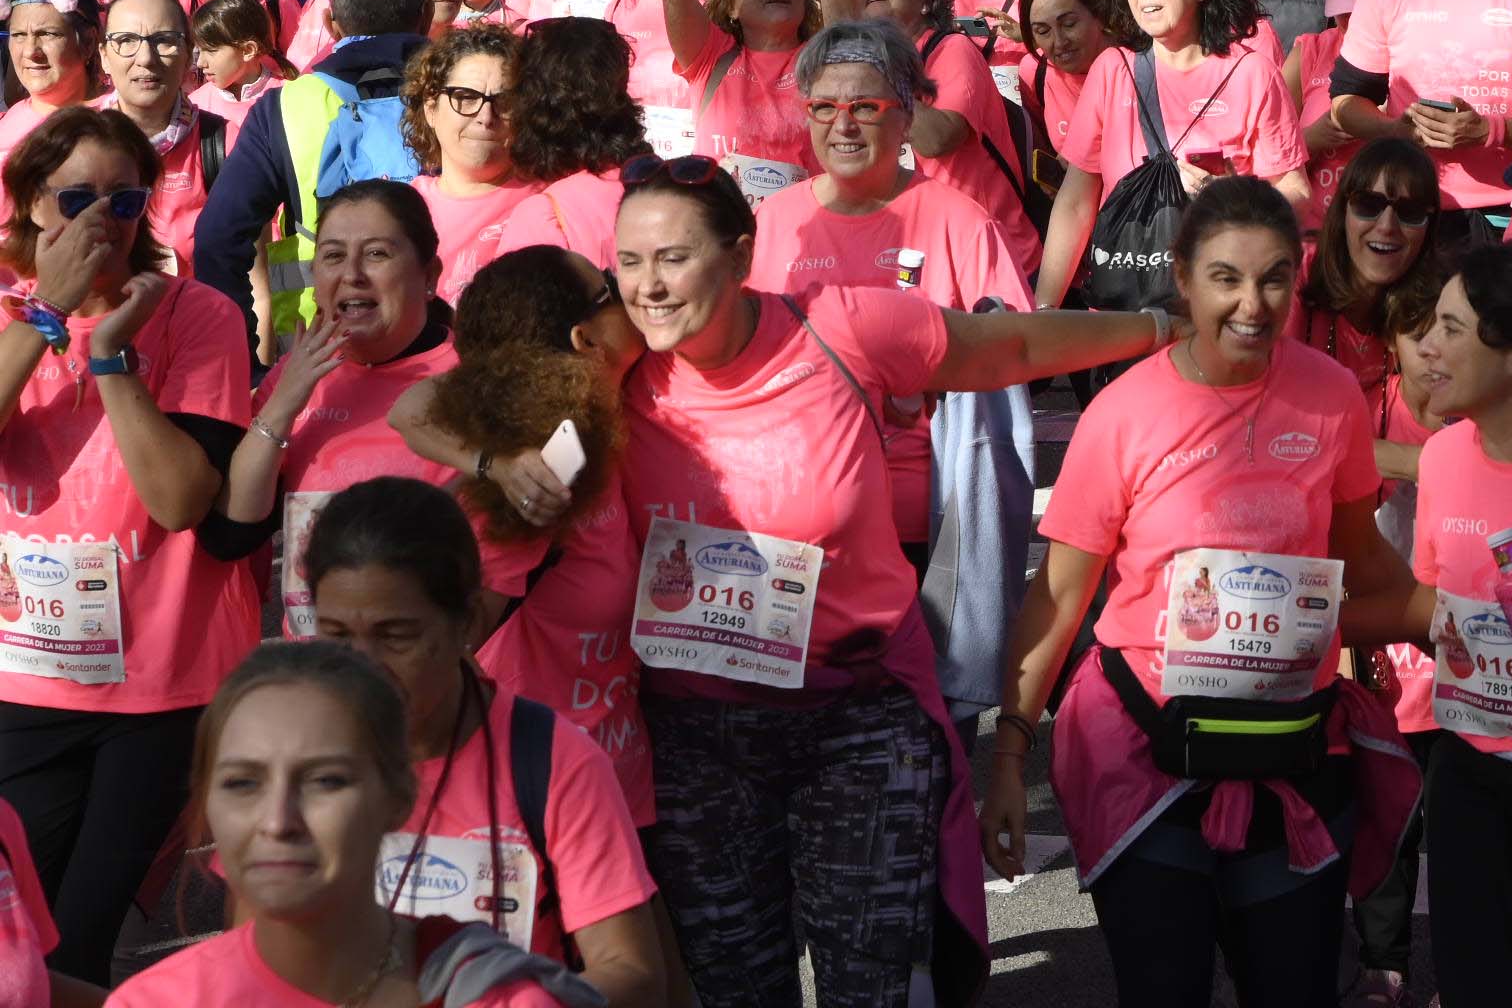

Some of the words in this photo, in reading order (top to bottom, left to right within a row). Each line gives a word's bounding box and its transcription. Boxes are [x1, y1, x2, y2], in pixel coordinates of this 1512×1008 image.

[1480, 71, 1510, 83] POR
[1460, 86, 1510, 98] TODAS
[786, 258, 835, 276] OYSHO
[1442, 517, 1487, 536] OYSHO
[74, 561, 105, 570] SUMA
[702, 552, 762, 575] ASTURIANA
[775, 558, 808, 573] SUMA
[19, 564, 64, 580] ASTURIANA
[1224, 577, 1286, 594] ASTURIANA
[1298, 578, 1329, 589] SUMA
[699, 584, 755, 611] 016
[24, 595, 65, 618] 016
[701, 610, 746, 630] 12949
[1225, 611, 1280, 636] 016
[31, 622, 61, 636] 18820
[45, 641, 55, 649] LA
[55, 642, 82, 652] MUJER
[654, 624, 701, 638] CARRERA
[701, 630, 716, 640] DE
[717, 633, 732, 643] LA
[732, 635, 765, 651] MUJER
[768, 644, 792, 656] 2023
[1229, 638, 1272, 654] 15479
[578, 631, 619, 666] TU
[645, 644, 699, 660] OYSHO
[65, 662, 112, 673] Santander
[738, 658, 792, 678] Santander
[1183, 654, 1230, 668] CARRERA
[1231, 658, 1244, 667] DE
[1245, 659, 1258, 669] LA
[1260, 661, 1290, 672] MUJER
[1177, 674, 1228, 690] OYSHO
[1483, 700, 1494, 709] DE
[1495, 702, 1506, 712] LA
